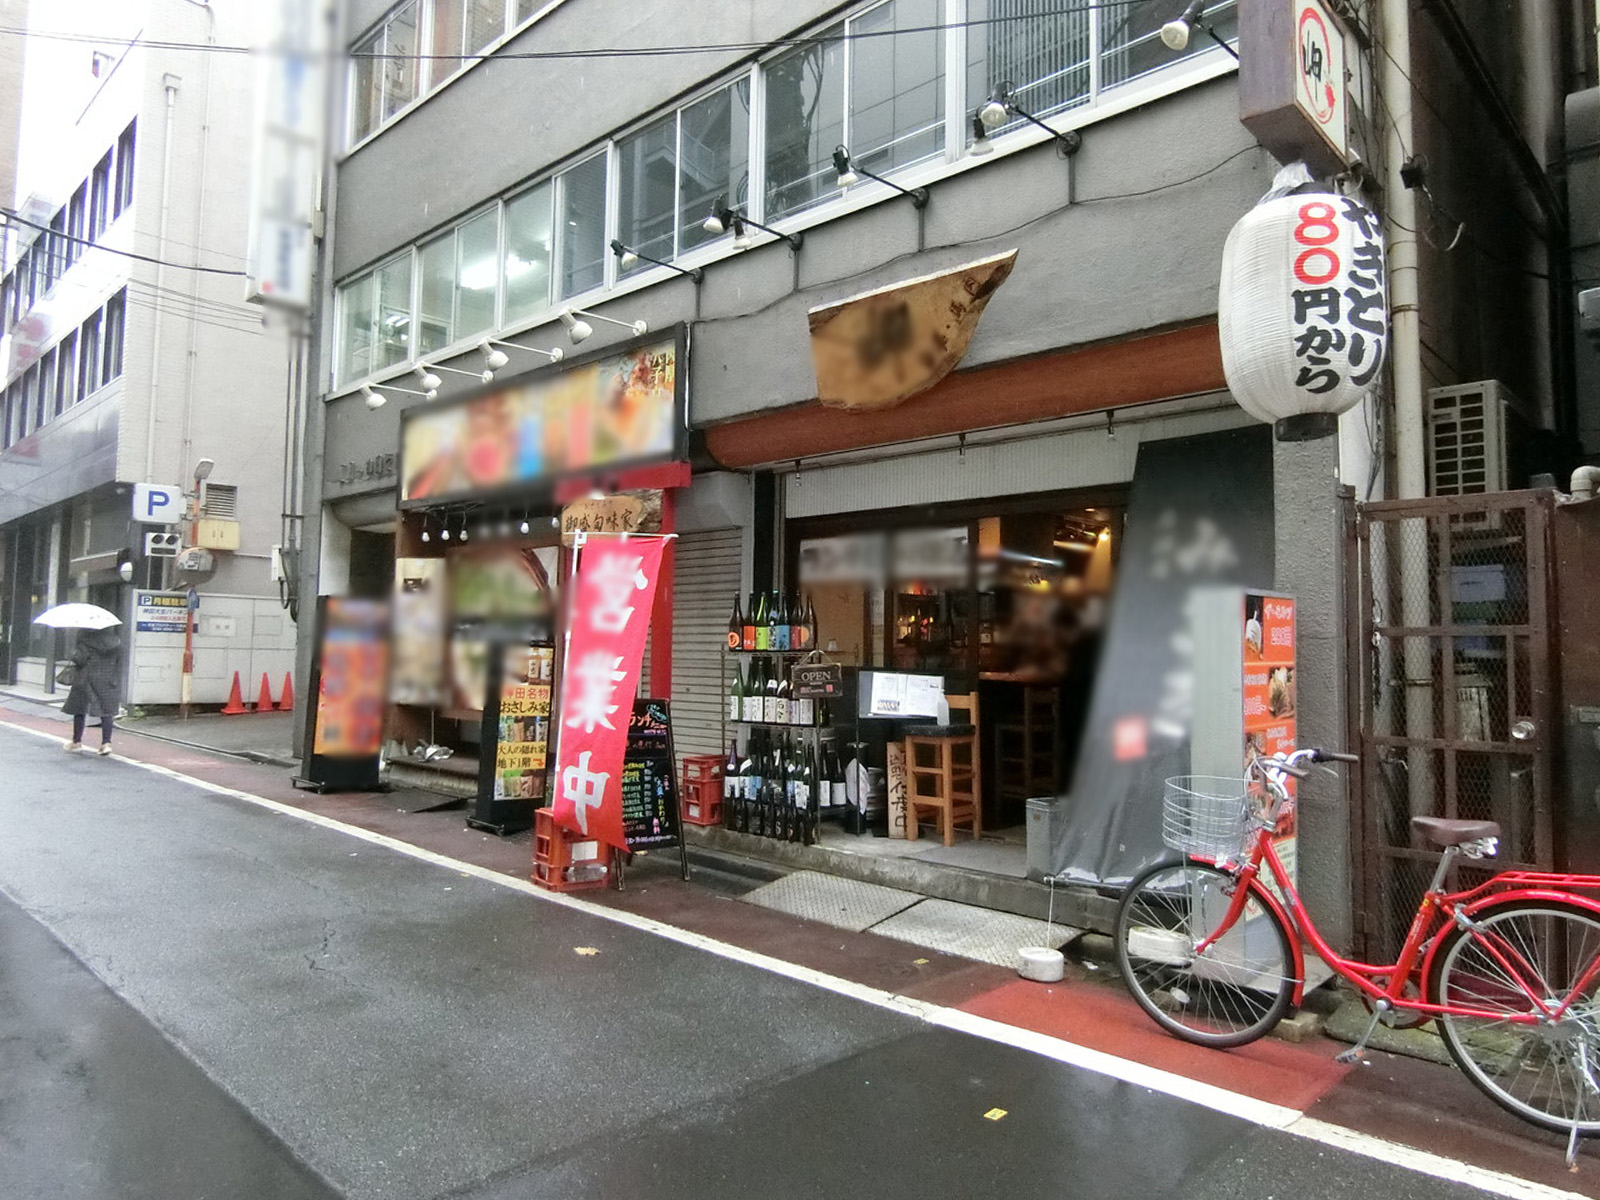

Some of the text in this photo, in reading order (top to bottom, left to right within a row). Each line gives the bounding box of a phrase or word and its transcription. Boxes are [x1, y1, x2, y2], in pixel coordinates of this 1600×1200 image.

[1291, 201, 1346, 394] 80円から
[1340, 197, 1384, 387] やきとり
[147, 490, 170, 516] P
[801, 671, 831, 681] OPEN
[504, 687, 549, 700] 田名物
